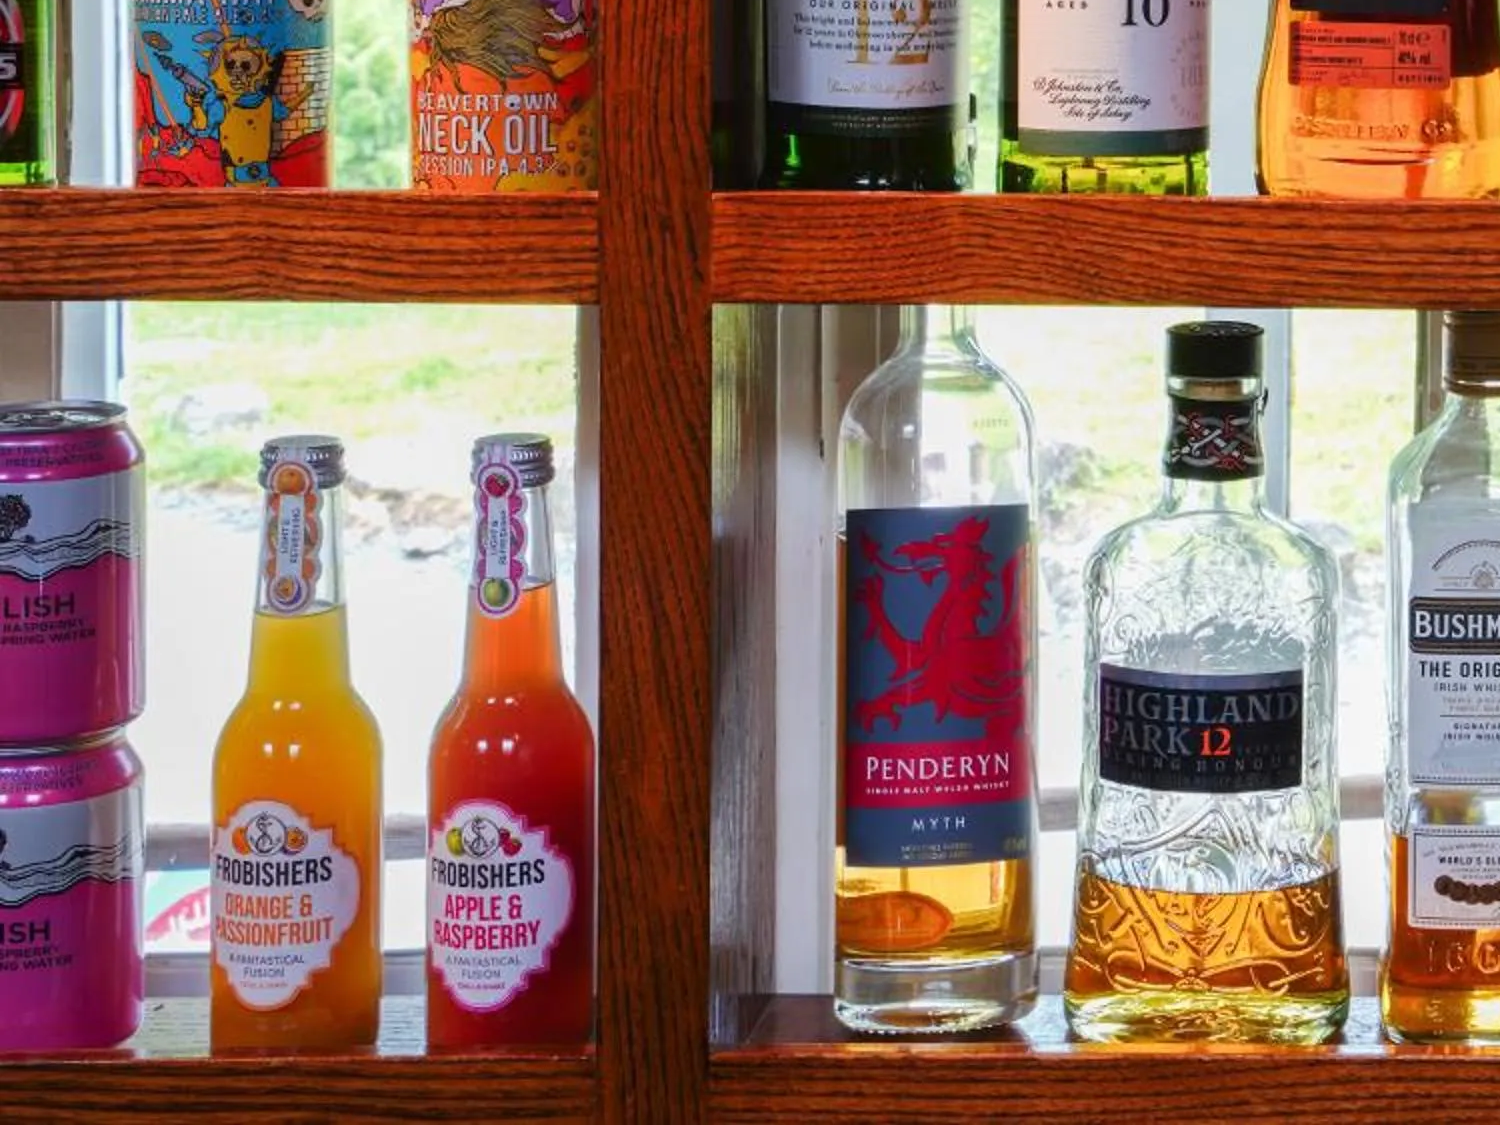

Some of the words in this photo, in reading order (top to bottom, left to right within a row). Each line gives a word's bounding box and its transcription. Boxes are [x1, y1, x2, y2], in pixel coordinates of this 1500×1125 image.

[1045, 0, 1089, 10] AGED
[418, 113, 496, 156] NECK
[503, 113, 558, 156] OIL
[419, 154, 474, 177] SESSION
[480, 155, 510, 177] IPA
[1419, 660, 1452, 679] THE
[1433, 682, 1468, 693] IRISH
[1103, 683, 1299, 724] HIGHLAND
[1102, 716, 1193, 760] PARK
[1199, 727, 1233, 756] 12
[865, 752, 1010, 781] PENDERYN
[911, 816, 966, 832] MYTH
[215, 854, 333, 887] FROBISHERS
[431, 856, 546, 890] FROBISHERS
[225, 892, 294, 919] ORANGE
[299, 894, 313, 918] &
[444, 894, 503, 922] APPLE
[508, 894, 523, 920] &
[434, 919, 541, 951] RASPBERRY
